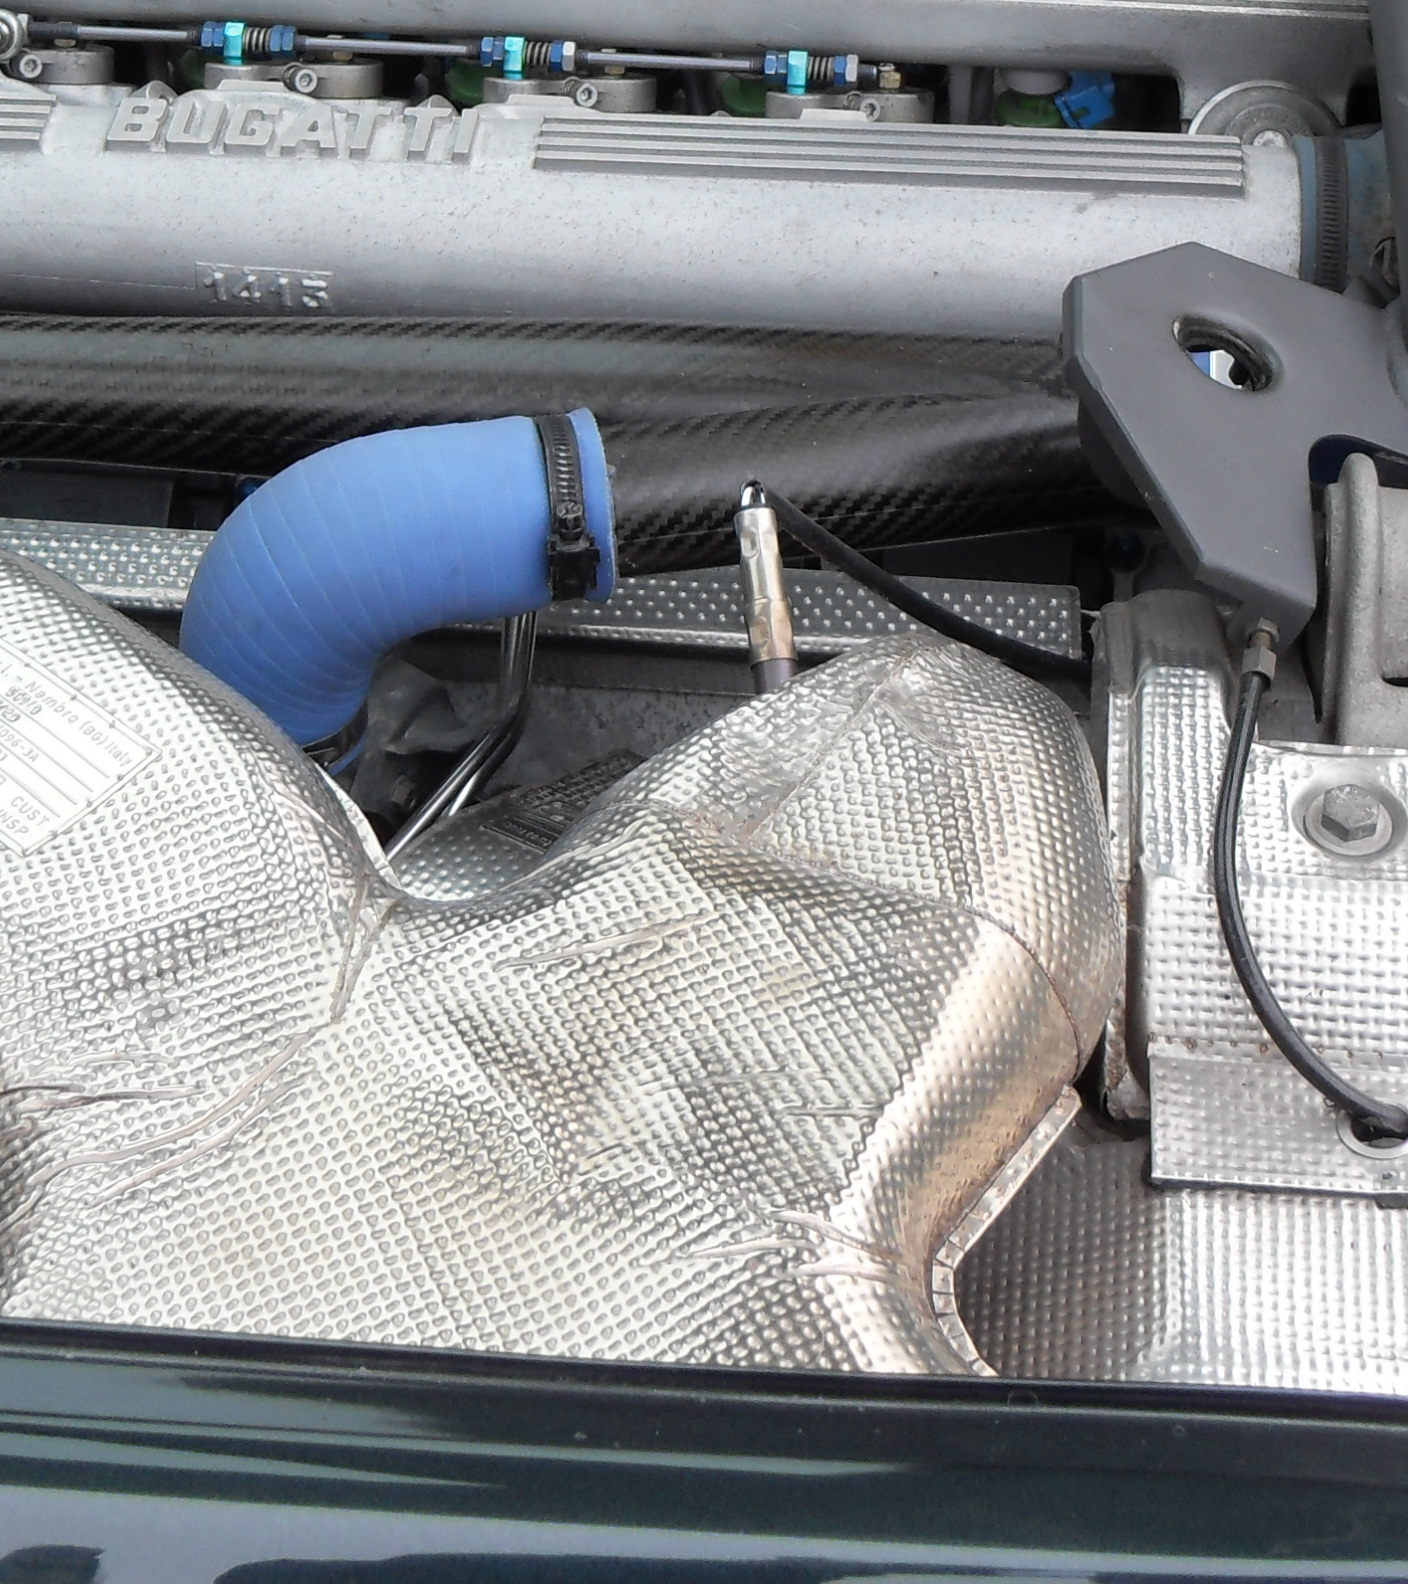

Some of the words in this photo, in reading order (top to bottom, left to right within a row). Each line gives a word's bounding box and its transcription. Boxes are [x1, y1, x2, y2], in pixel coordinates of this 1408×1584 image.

[106, 97, 480, 162] BUGATTI
[105, 742, 134, 766] Italy
[10, 796, 50, 826] CUST
